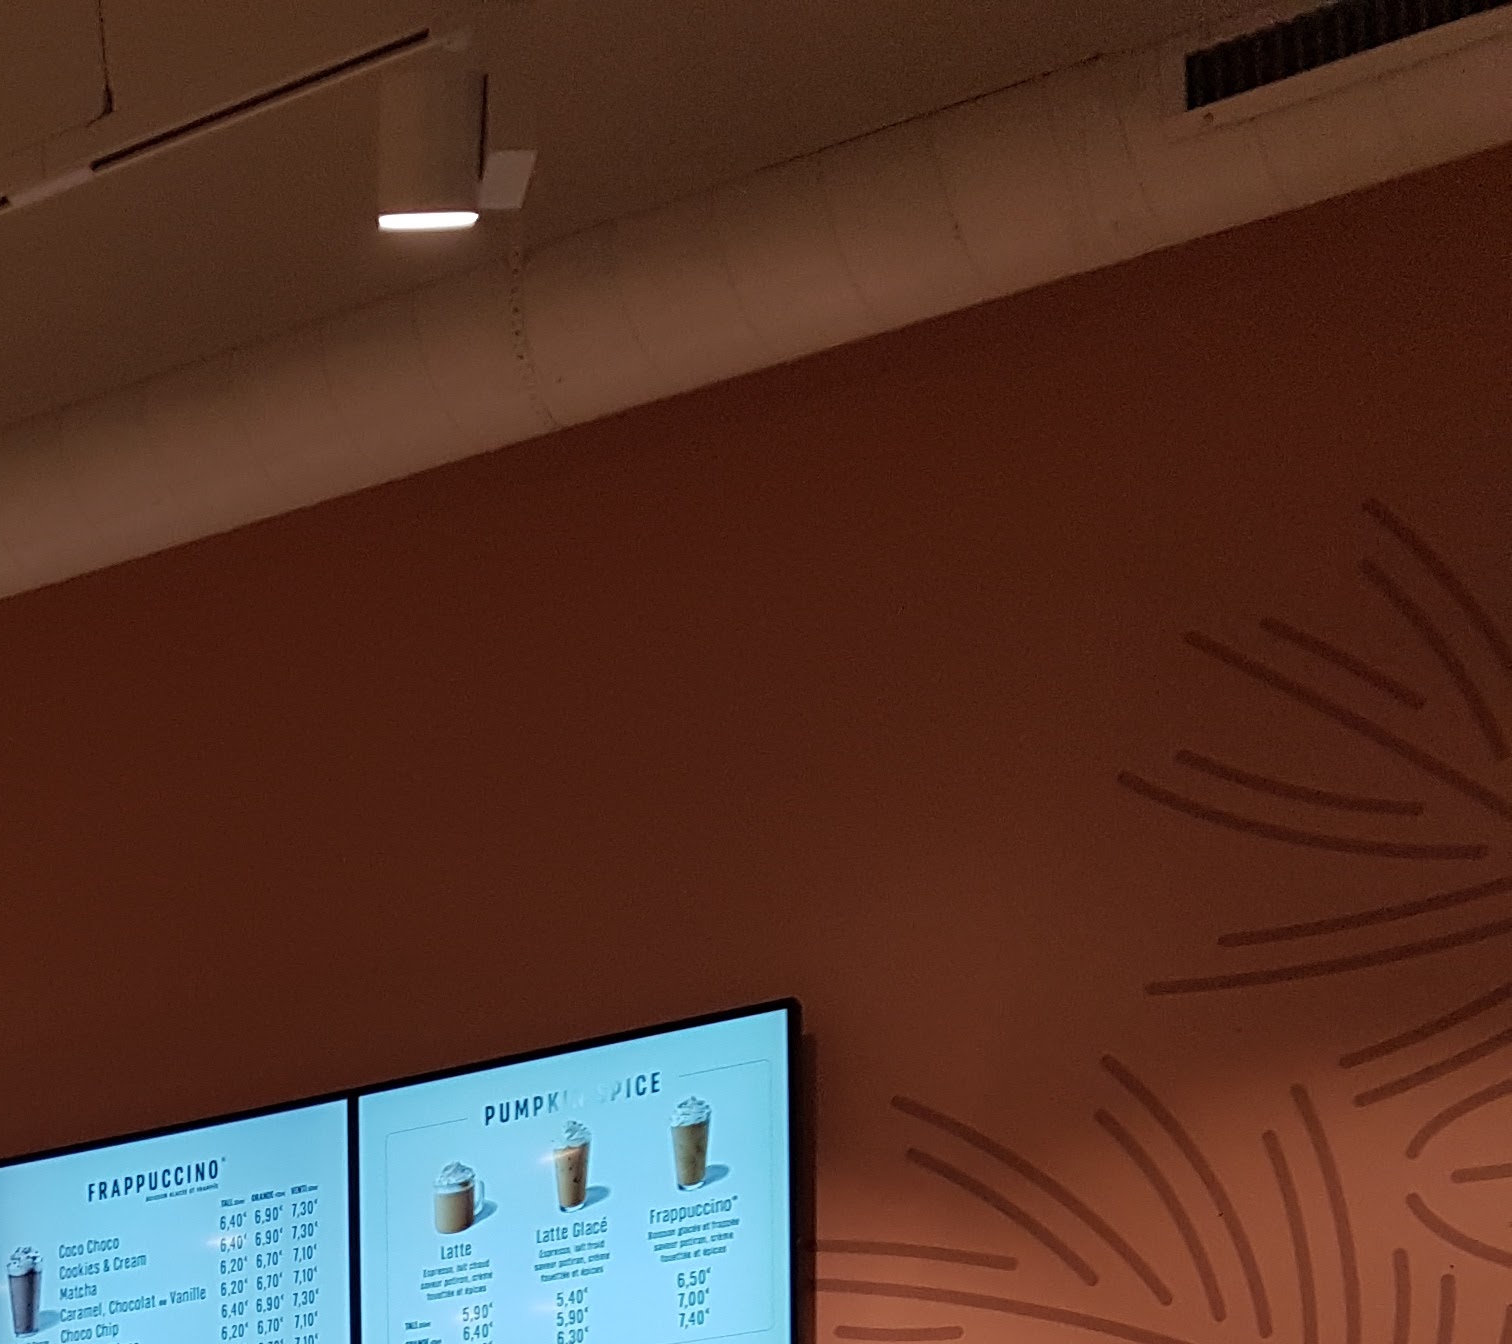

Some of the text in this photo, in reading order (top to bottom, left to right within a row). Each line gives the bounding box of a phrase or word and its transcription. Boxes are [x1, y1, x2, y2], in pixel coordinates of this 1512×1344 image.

[536, 1217, 608, 1244] Latte Glacé
[58, 1237, 120, 1259] Coco Choco
[440, 1243, 472, 1261] Latte
[59, 1254, 147, 1281] Cookies & Cream
[60, 1283, 97, 1300] Matcha
[109, 1294, 156, 1314] Chocolat
[170, 1287, 207, 1306] Vanille
[61, 1323, 119, 1344] Choco Chip
